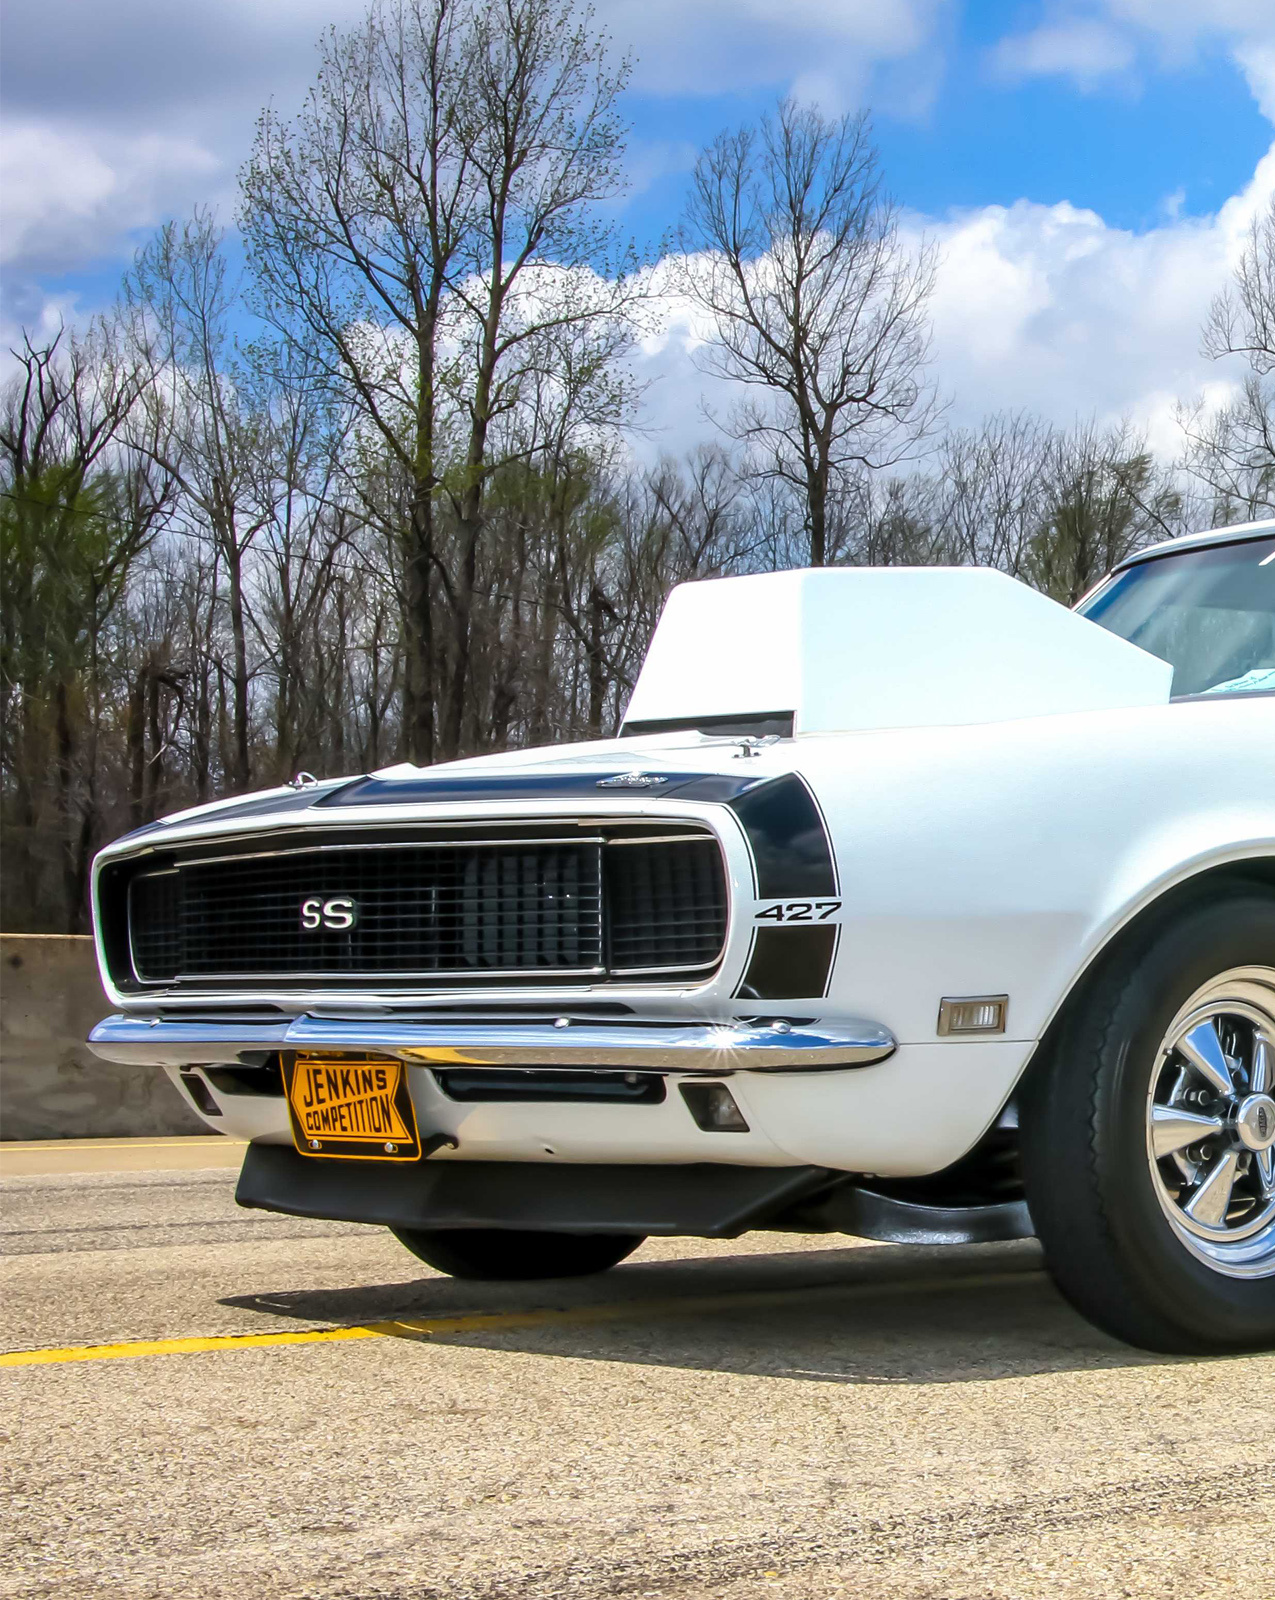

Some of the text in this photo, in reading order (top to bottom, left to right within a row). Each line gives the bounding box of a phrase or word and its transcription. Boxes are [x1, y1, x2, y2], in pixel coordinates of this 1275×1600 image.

[302, 900, 354, 930] SS
[754, 902, 842, 921] 427
[303, 1068, 388, 1108] JENKINS
[306, 1093, 393, 1134] COMPETITION
